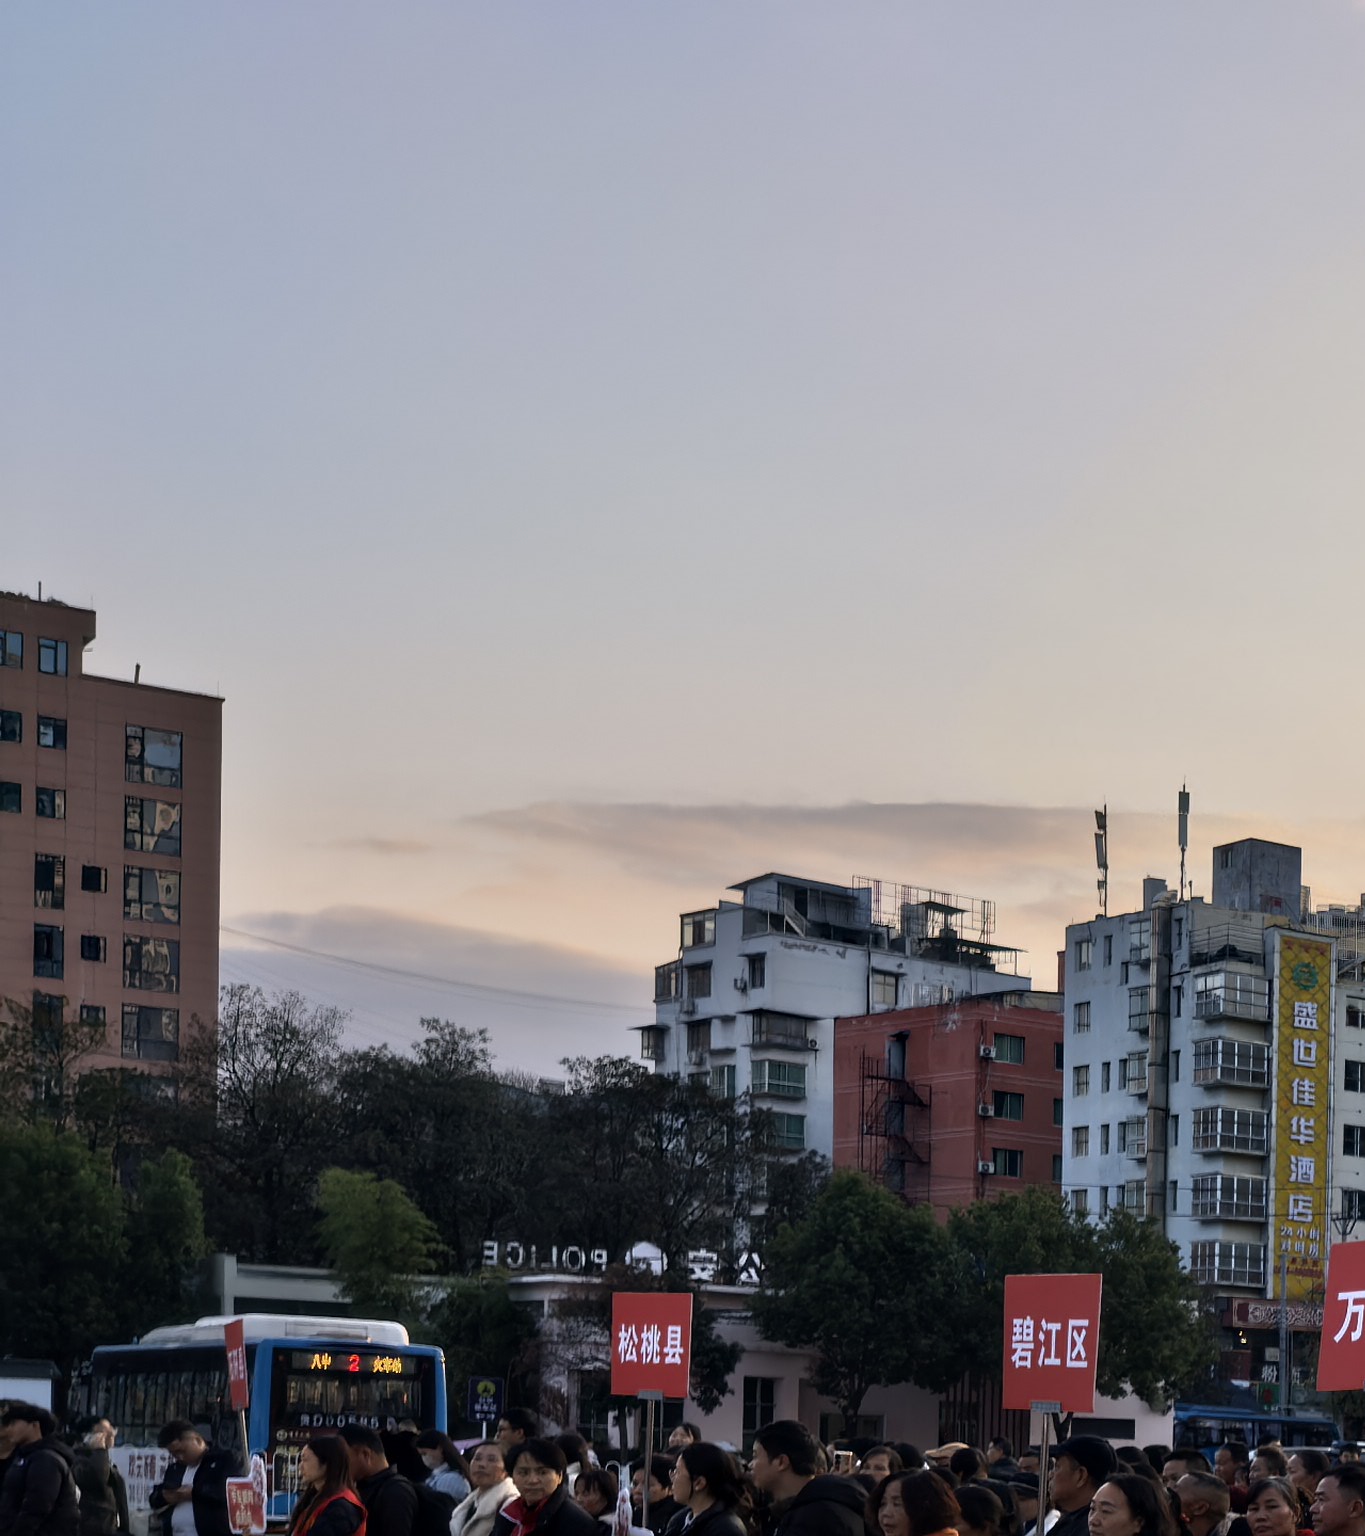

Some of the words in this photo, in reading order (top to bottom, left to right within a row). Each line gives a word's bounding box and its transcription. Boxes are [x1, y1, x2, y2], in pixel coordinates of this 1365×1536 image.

[1287, 1001, 1319, 1224] 盛世佳华酒店
[350, 1354, 360, 1372] 2
[618, 1323, 684, 1365] 松桃县
[1010, 1318, 1090, 1371] 碧江区
